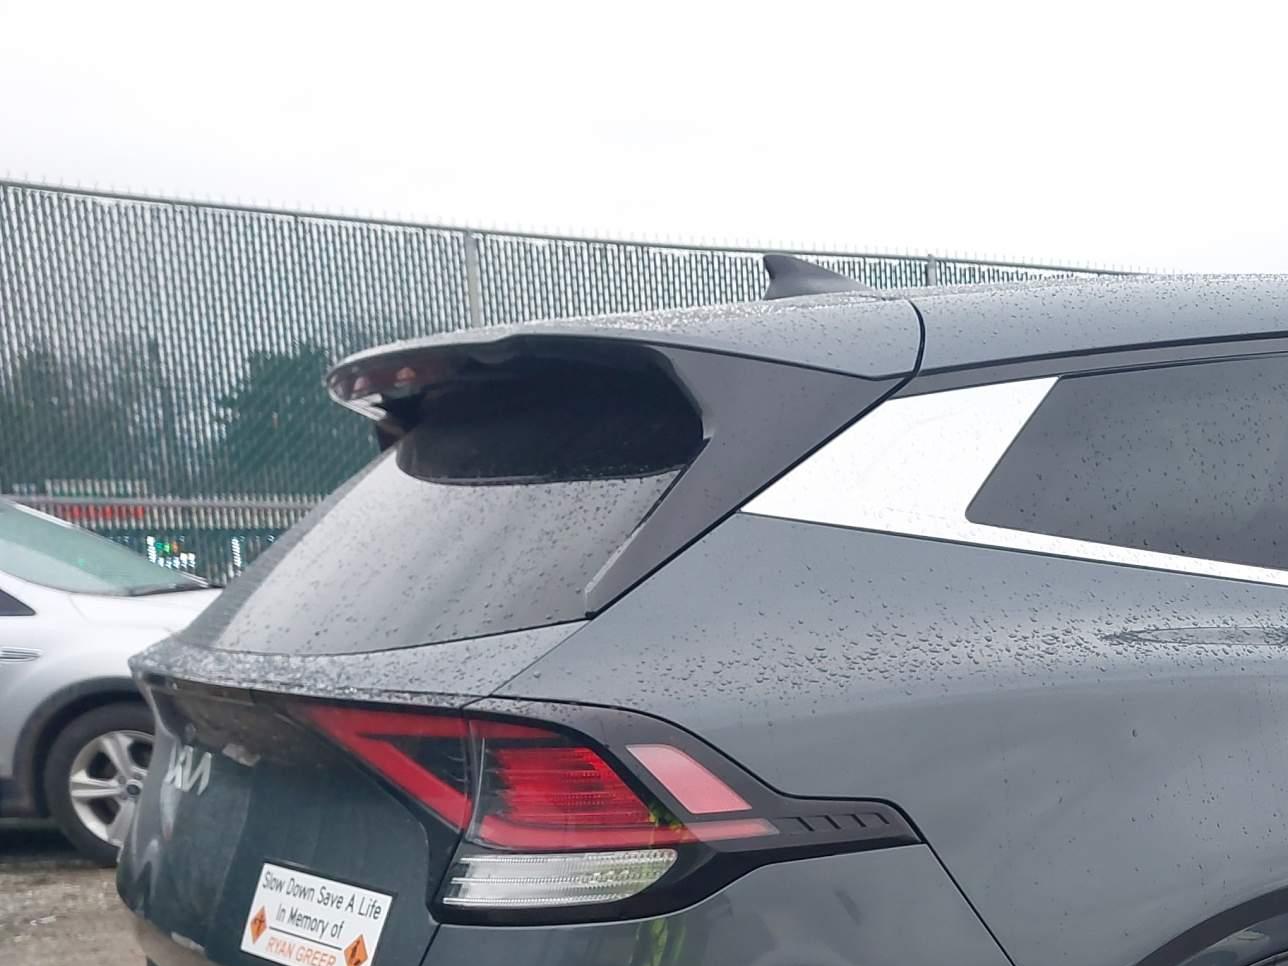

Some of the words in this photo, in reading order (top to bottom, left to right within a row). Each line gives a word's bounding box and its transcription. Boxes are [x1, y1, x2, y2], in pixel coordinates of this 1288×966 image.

[262, 871, 286, 893] Slow
[286, 878, 315, 901] Down
[317, 886, 344, 909] Save
[345, 895, 357, 913] A
[358, 896, 382, 920] Life
[276, 903, 287, 923] In
[288, 908, 328, 939] Memory
[330, 920, 345, 940] of
[265, 937, 293, 961] RYAN
